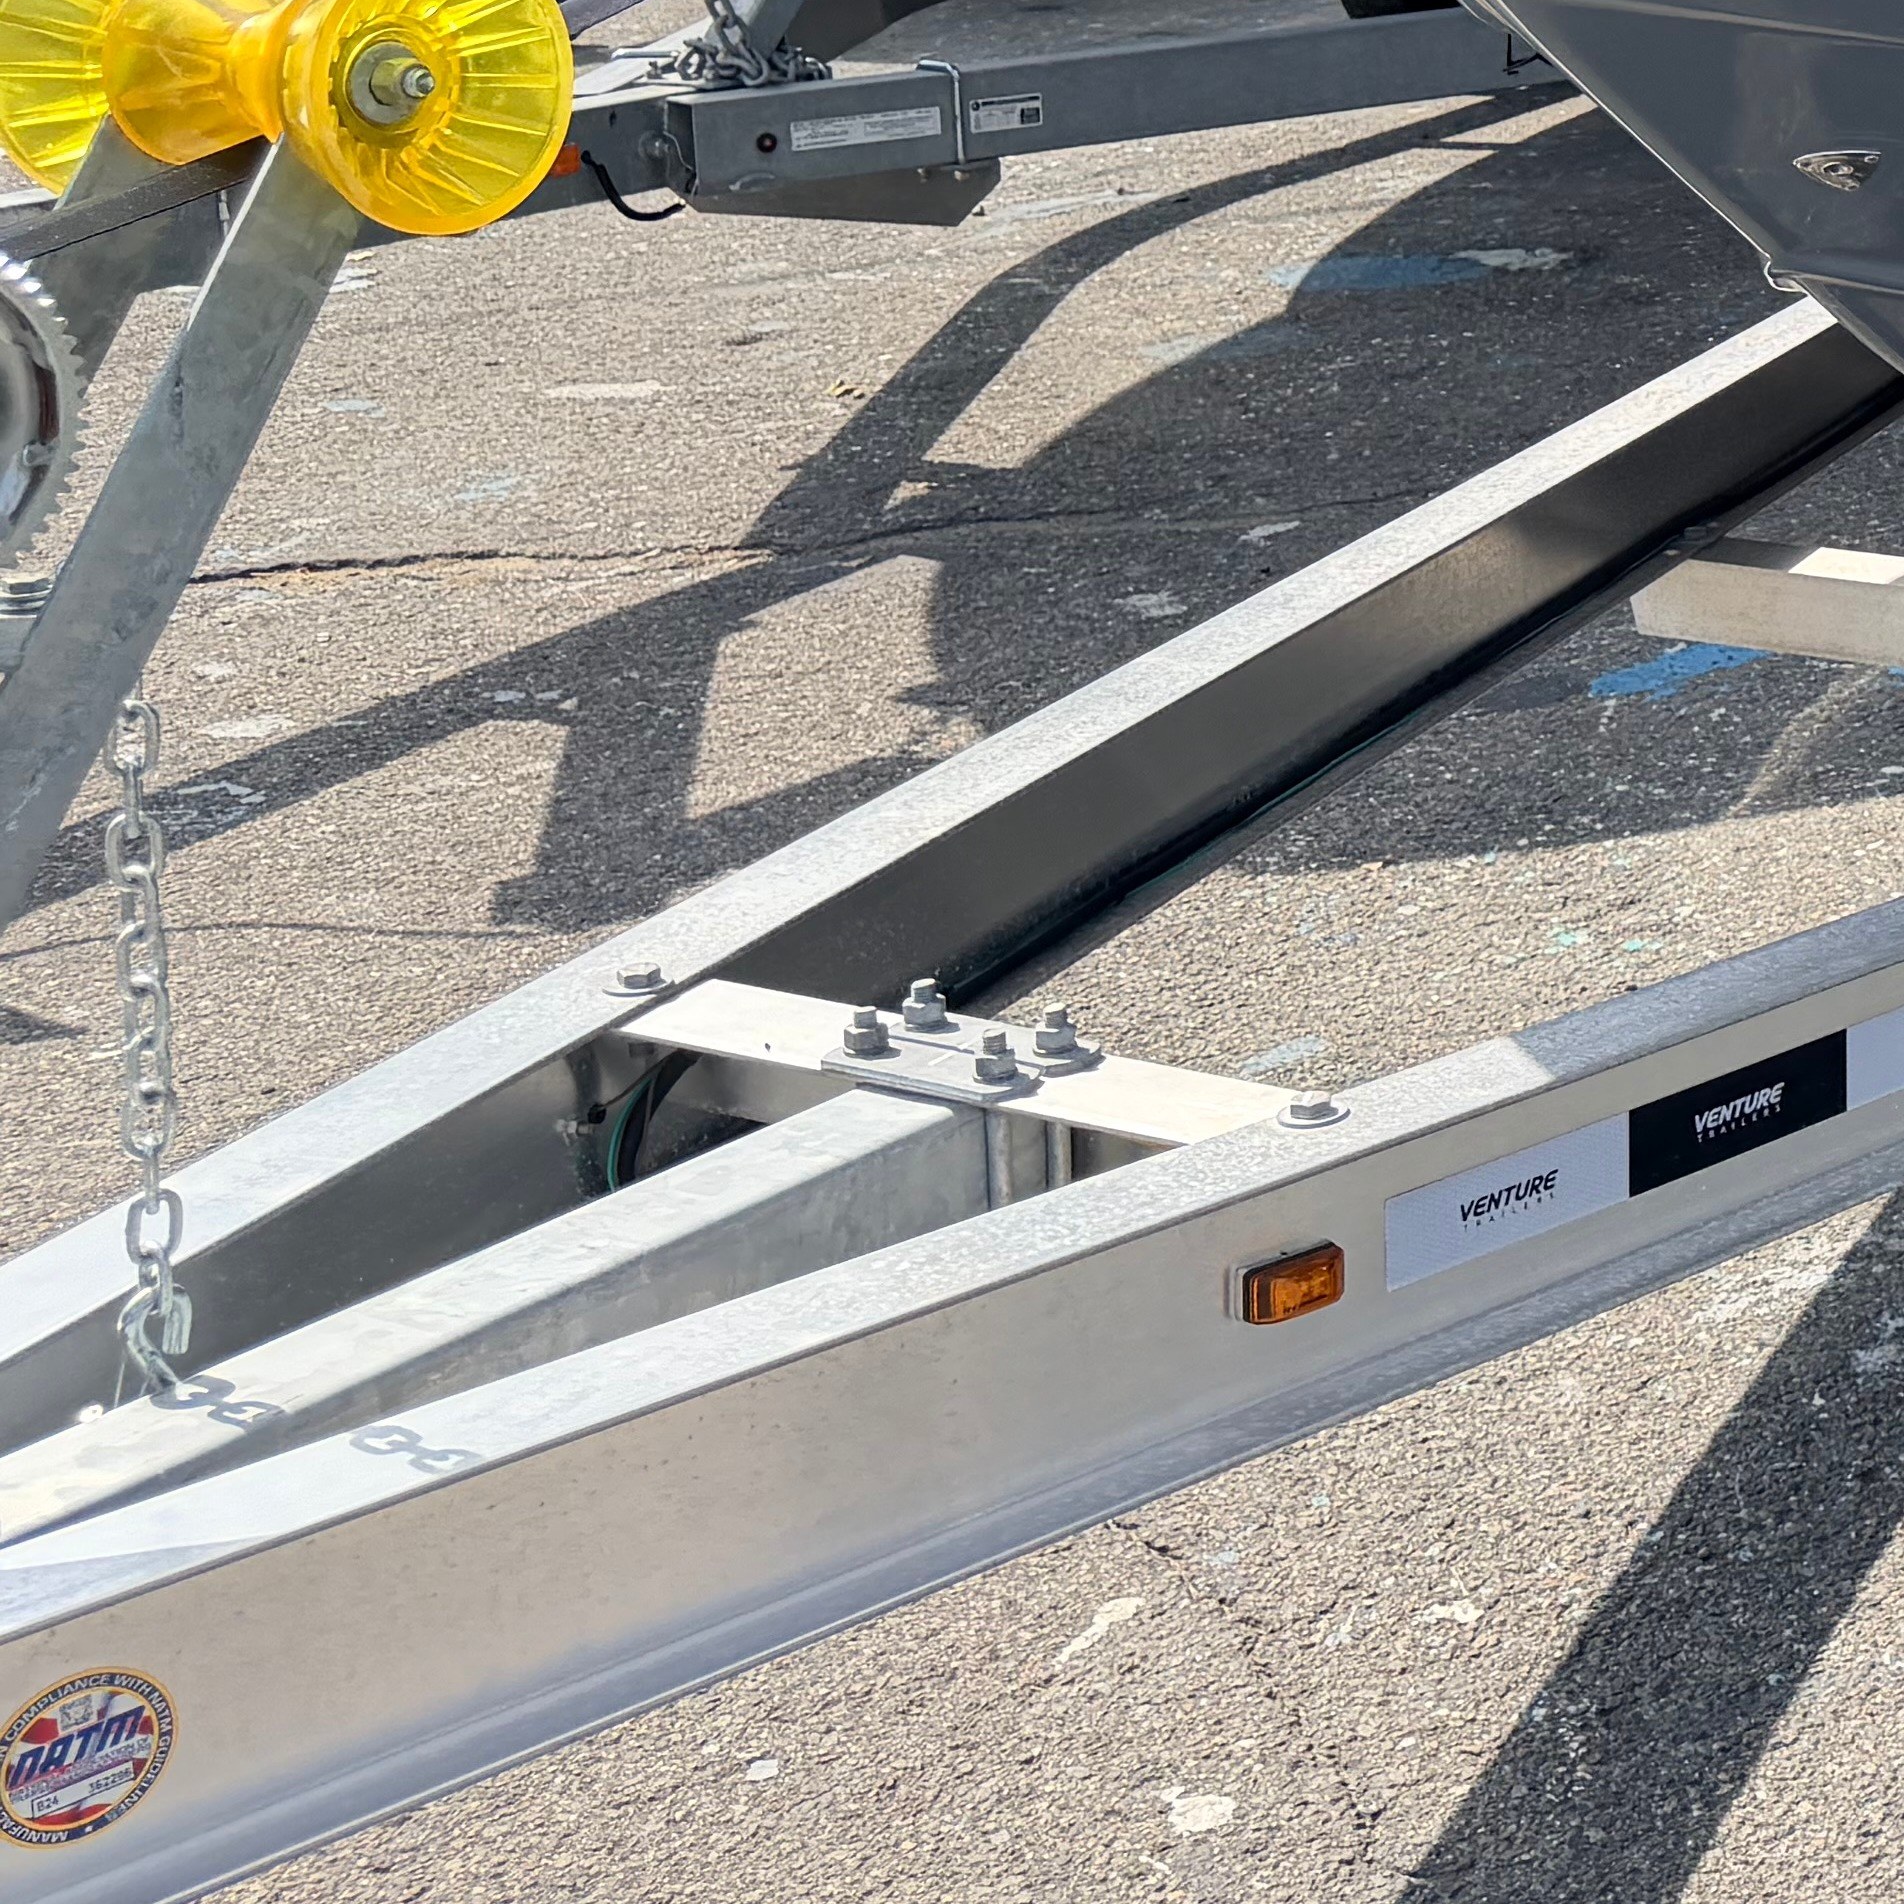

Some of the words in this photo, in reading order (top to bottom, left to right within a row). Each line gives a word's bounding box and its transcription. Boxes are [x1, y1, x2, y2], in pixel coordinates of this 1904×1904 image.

[1695, 1081, 1785, 1133] VENTURE
[1460, 1168, 1559, 1222] VENTURE
[113, 1674, 152, 1697] WITH
